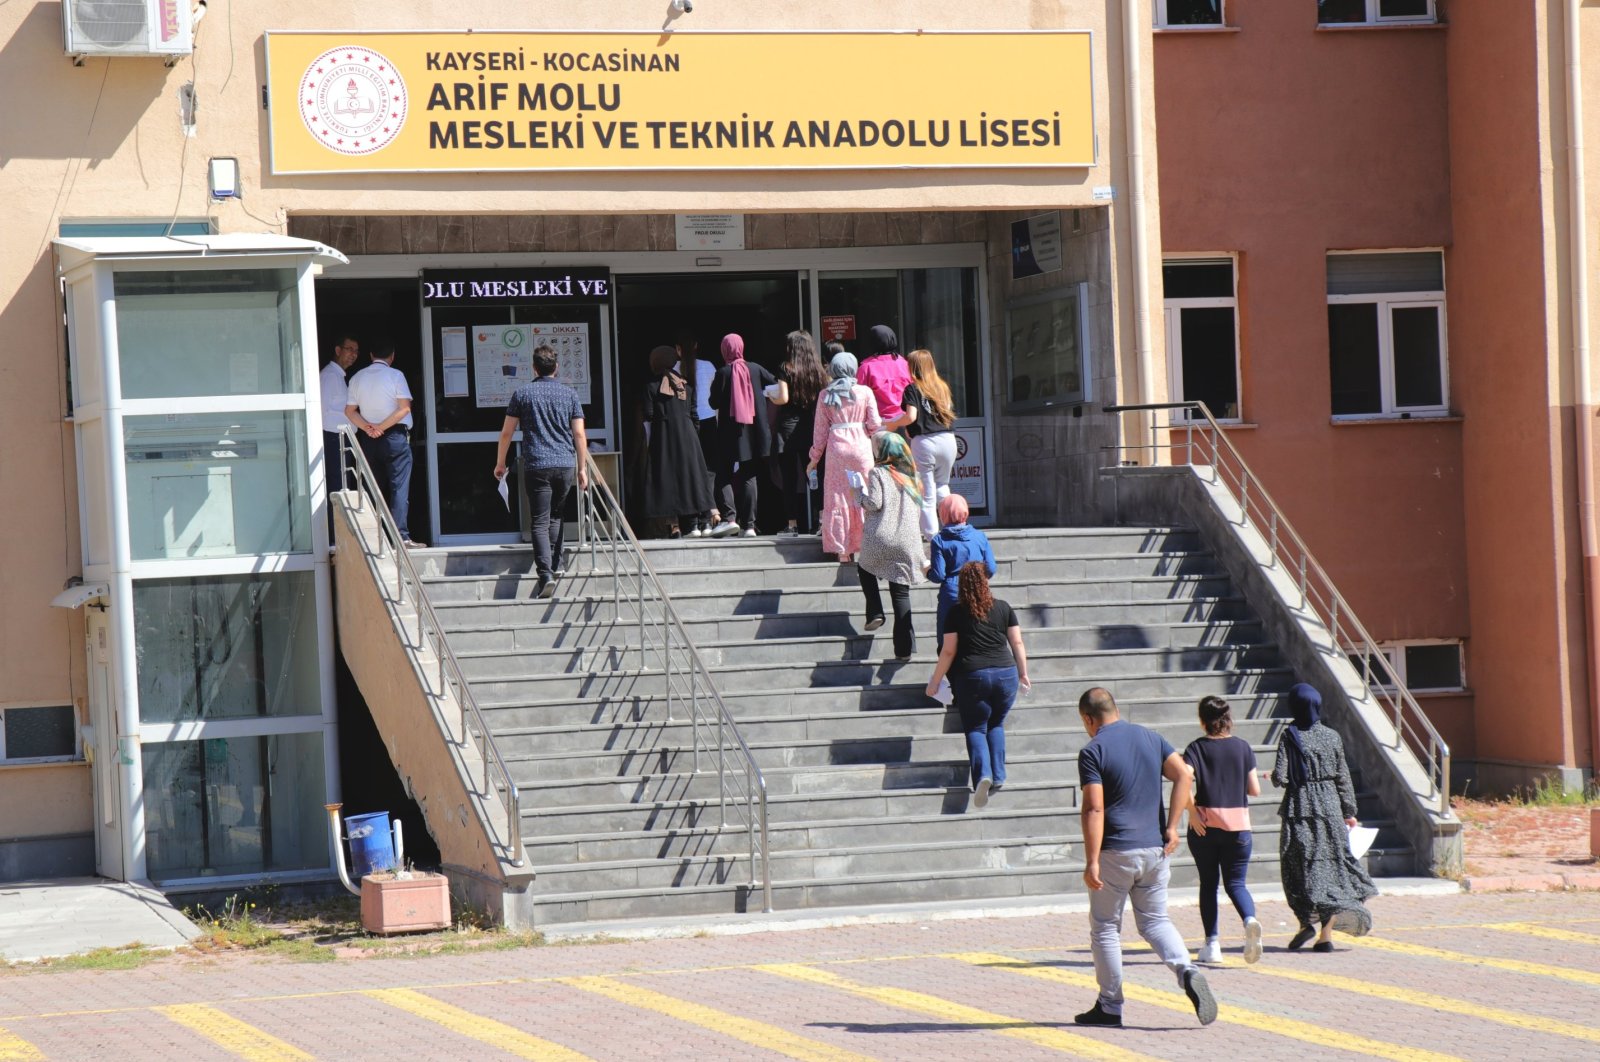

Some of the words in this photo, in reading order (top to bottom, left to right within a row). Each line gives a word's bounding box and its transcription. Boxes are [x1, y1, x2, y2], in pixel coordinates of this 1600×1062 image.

[166, 0, 178, 40] VEST
[427, 47, 524, 72] KAYSERİ
[544, 48, 680, 72] KOCASİNAN
[427, 75, 508, 111] ARİF
[518, 83, 621, 112] MOLU
[427, 113, 586, 149] MESLEKİ
[593, 122, 639, 149] VE
[646, 113, 775, 149] TEKNİK
[783, 119, 950, 148] ANADOLU
[960, 111, 1061, 147] LİSESİ
[470, 276, 573, 297] MESLEKİ
[578, 280, 608, 296] VE
[552, 325, 580, 334] DİKKAT
[957, 464, 981, 480] İÇİLMEZ
